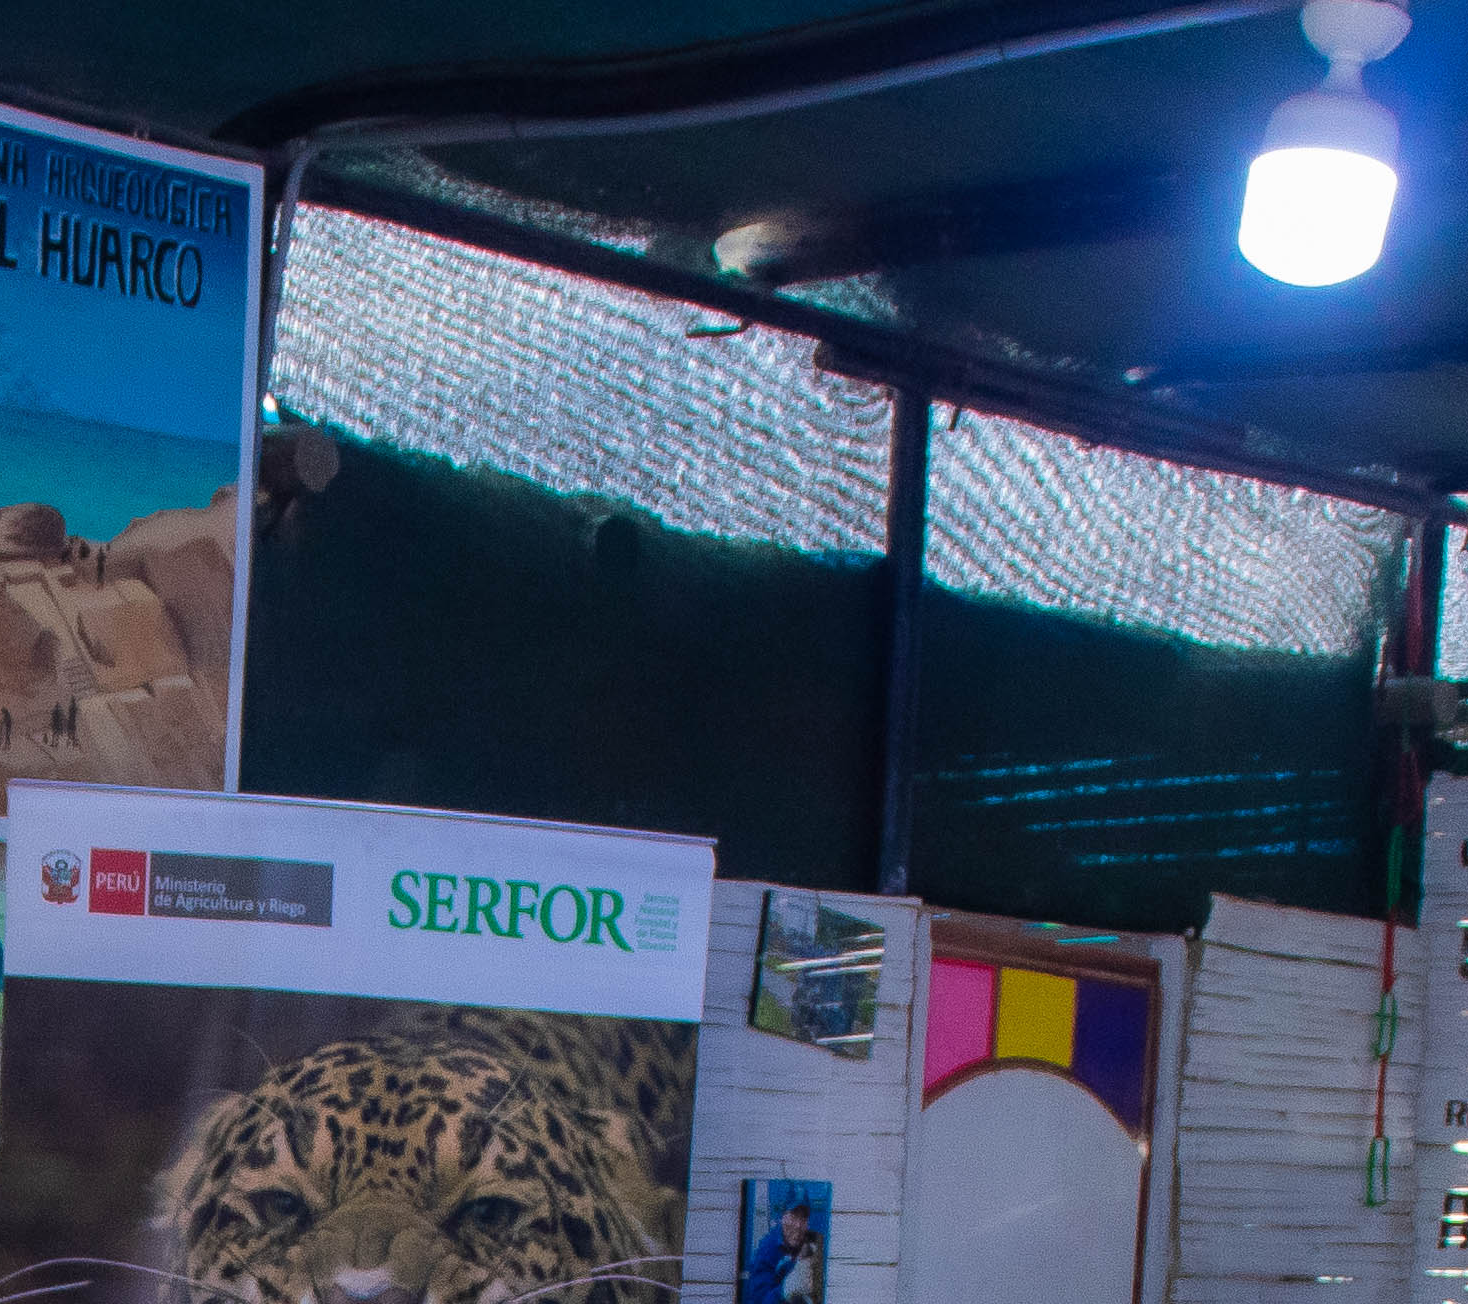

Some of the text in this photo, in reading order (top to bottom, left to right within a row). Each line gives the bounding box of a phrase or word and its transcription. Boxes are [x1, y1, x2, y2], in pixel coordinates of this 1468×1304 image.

[38, 206, 203, 308] HUARCO
[95, 871, 140, 892] PERÚ
[155, 875, 226, 896] Ministerio
[154, 892, 307, 917] de Agricultura y Riego
[387, 869, 634, 953] SERFOR
